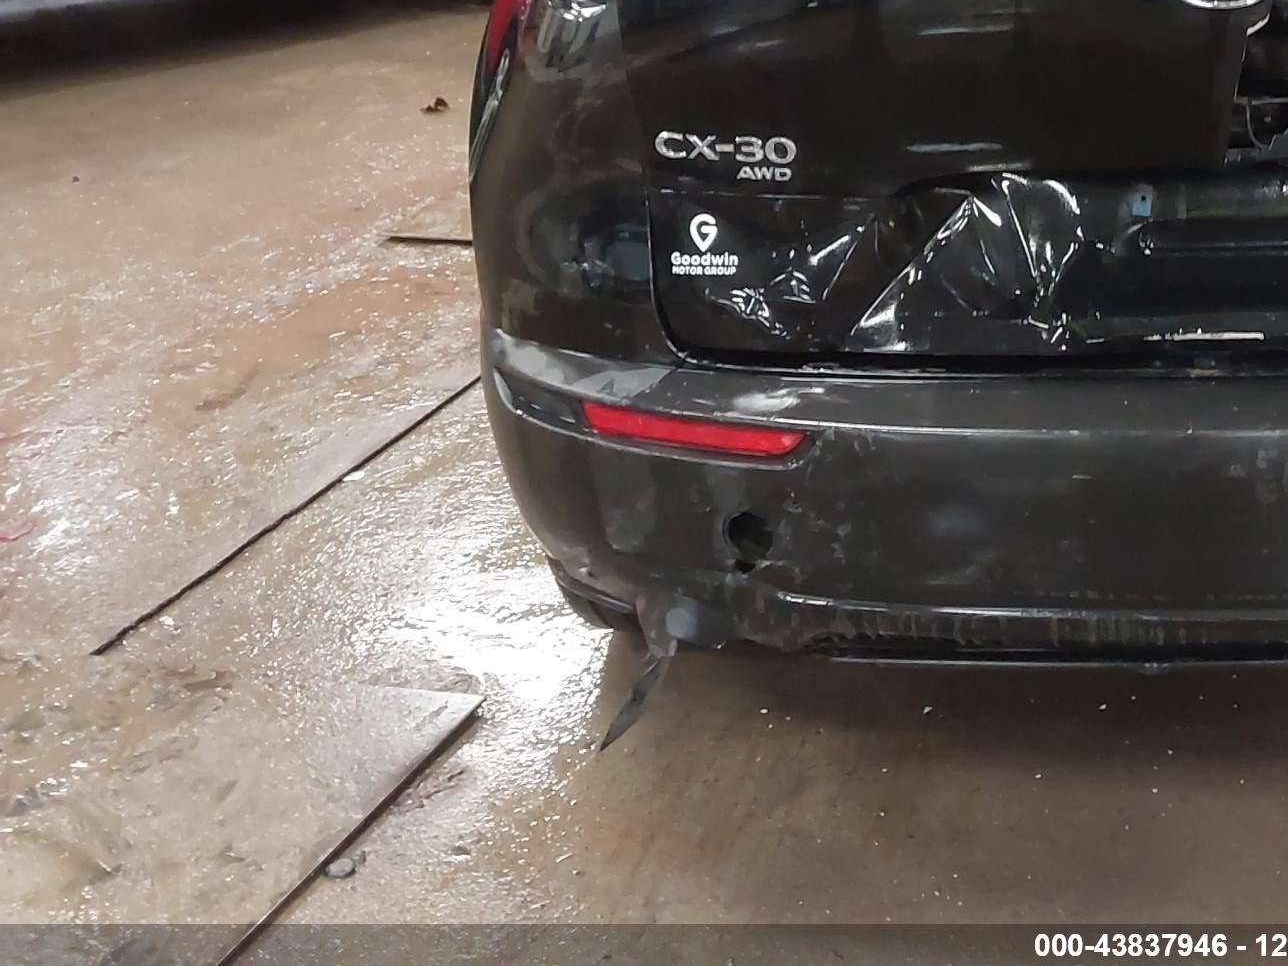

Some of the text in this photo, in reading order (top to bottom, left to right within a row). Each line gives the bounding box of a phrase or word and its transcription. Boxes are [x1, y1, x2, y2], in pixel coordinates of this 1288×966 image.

[655, 131, 797, 164] CX-30
[736, 166, 792, 181] AWD
[671, 252, 739, 266] Goodwin
[672, 266, 737, 275] MOTOR GROUP
